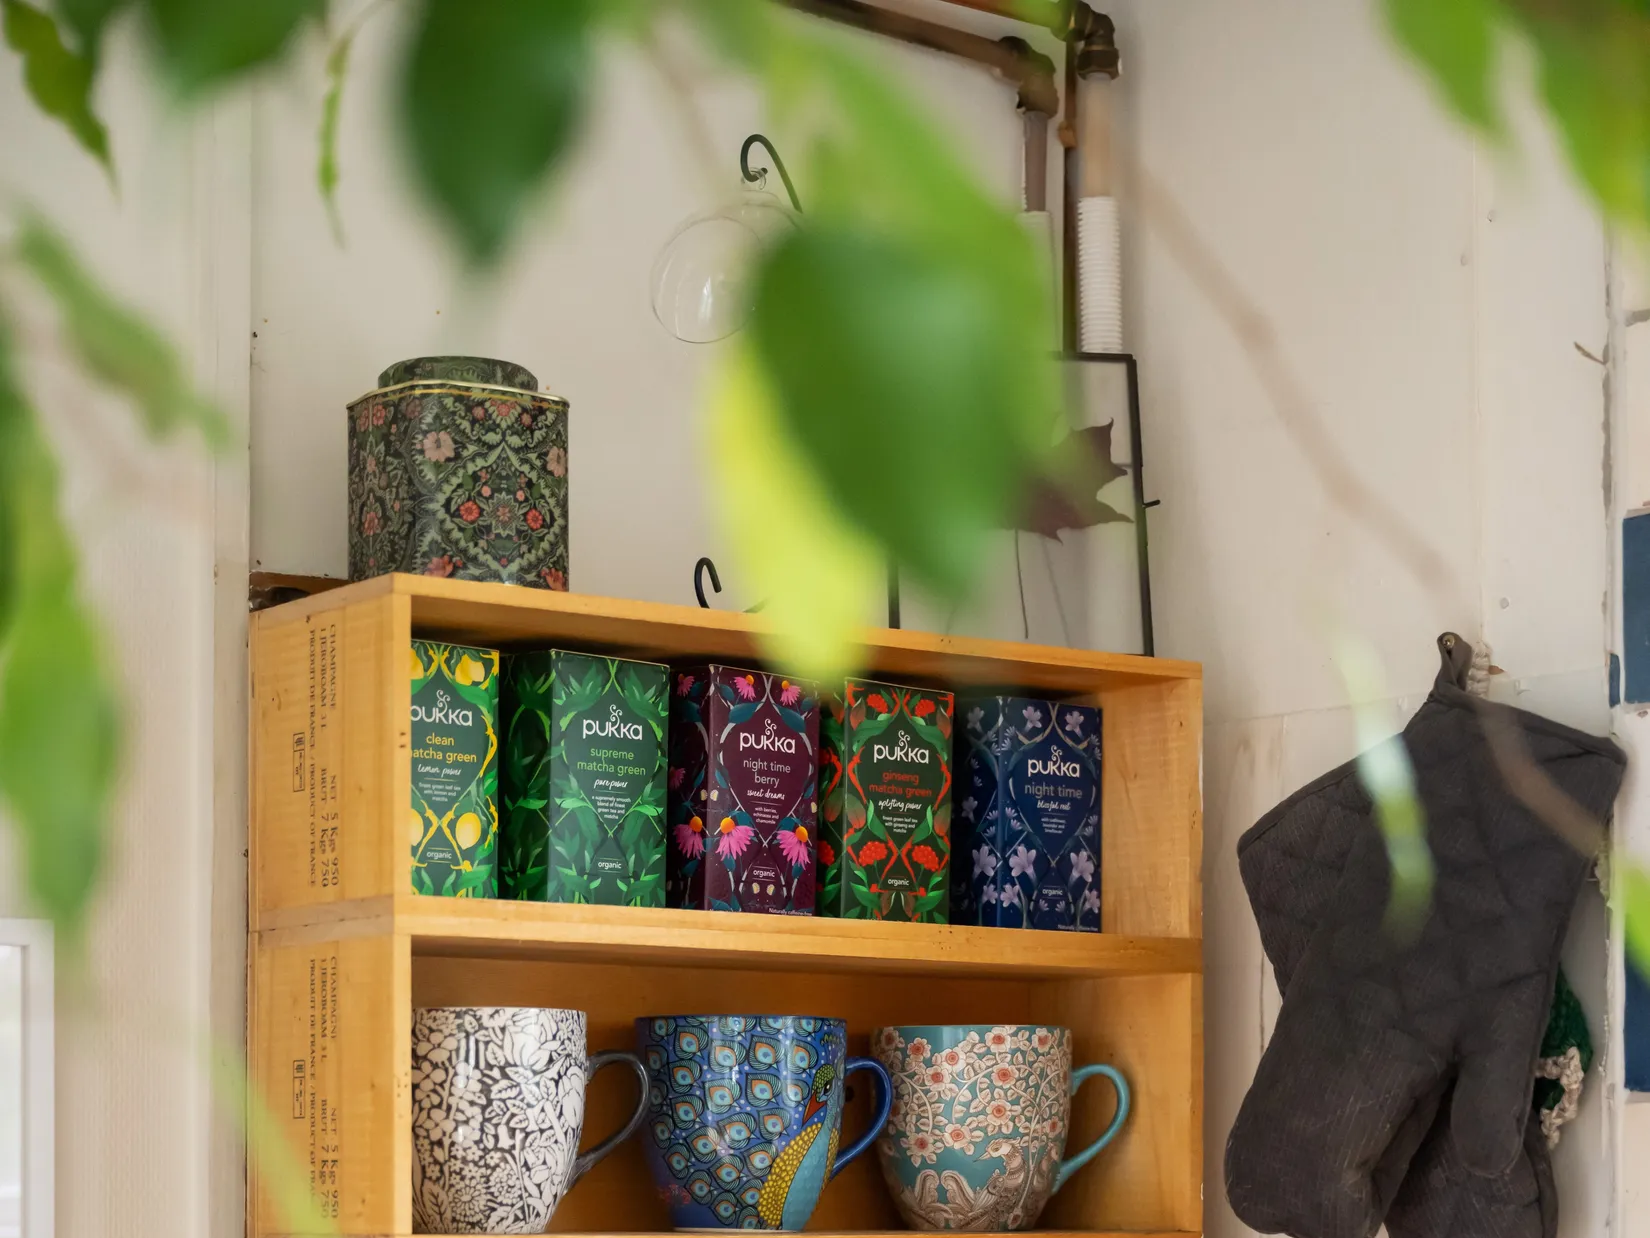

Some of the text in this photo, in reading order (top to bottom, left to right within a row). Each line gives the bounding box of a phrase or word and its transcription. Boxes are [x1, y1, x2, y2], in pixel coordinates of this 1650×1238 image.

[582, 704, 643, 740] pukka
[425, 732, 455, 746] clean
[739, 718, 796, 754] pukka
[590, 747, 635, 762] supreme
[873, 729, 929, 764] pukka
[411, 747, 477, 764] atcha green
[1027, 744, 1080, 778] pukka
[417, 763, 440, 774] lemon
[577, 760, 646, 777] matcha green
[743, 757, 791, 773] night time
[754, 771, 780, 789] berry
[882, 770, 919, 786] ginseng
[746, 788, 785, 800] sweet dreams
[868, 783, 933, 799] matcha green
[1024, 781, 1083, 799] night time
[320, 828, 328, 854] Kgs
[329, 826, 338, 853] Kgs
[426, 851, 452, 860] organic
[321, 858, 329, 887] 750
[330, 857, 339, 886] 950
[597, 861, 622, 870] organic
[752, 869, 776, 879] organic
[887, 878, 910, 887] organic
[1042, 888, 1063, 897] organic
[319, 1159, 329, 1184] Kgs
[329, 1159, 339, 1184] Kgs
[331, 1189, 339, 1218] 950
